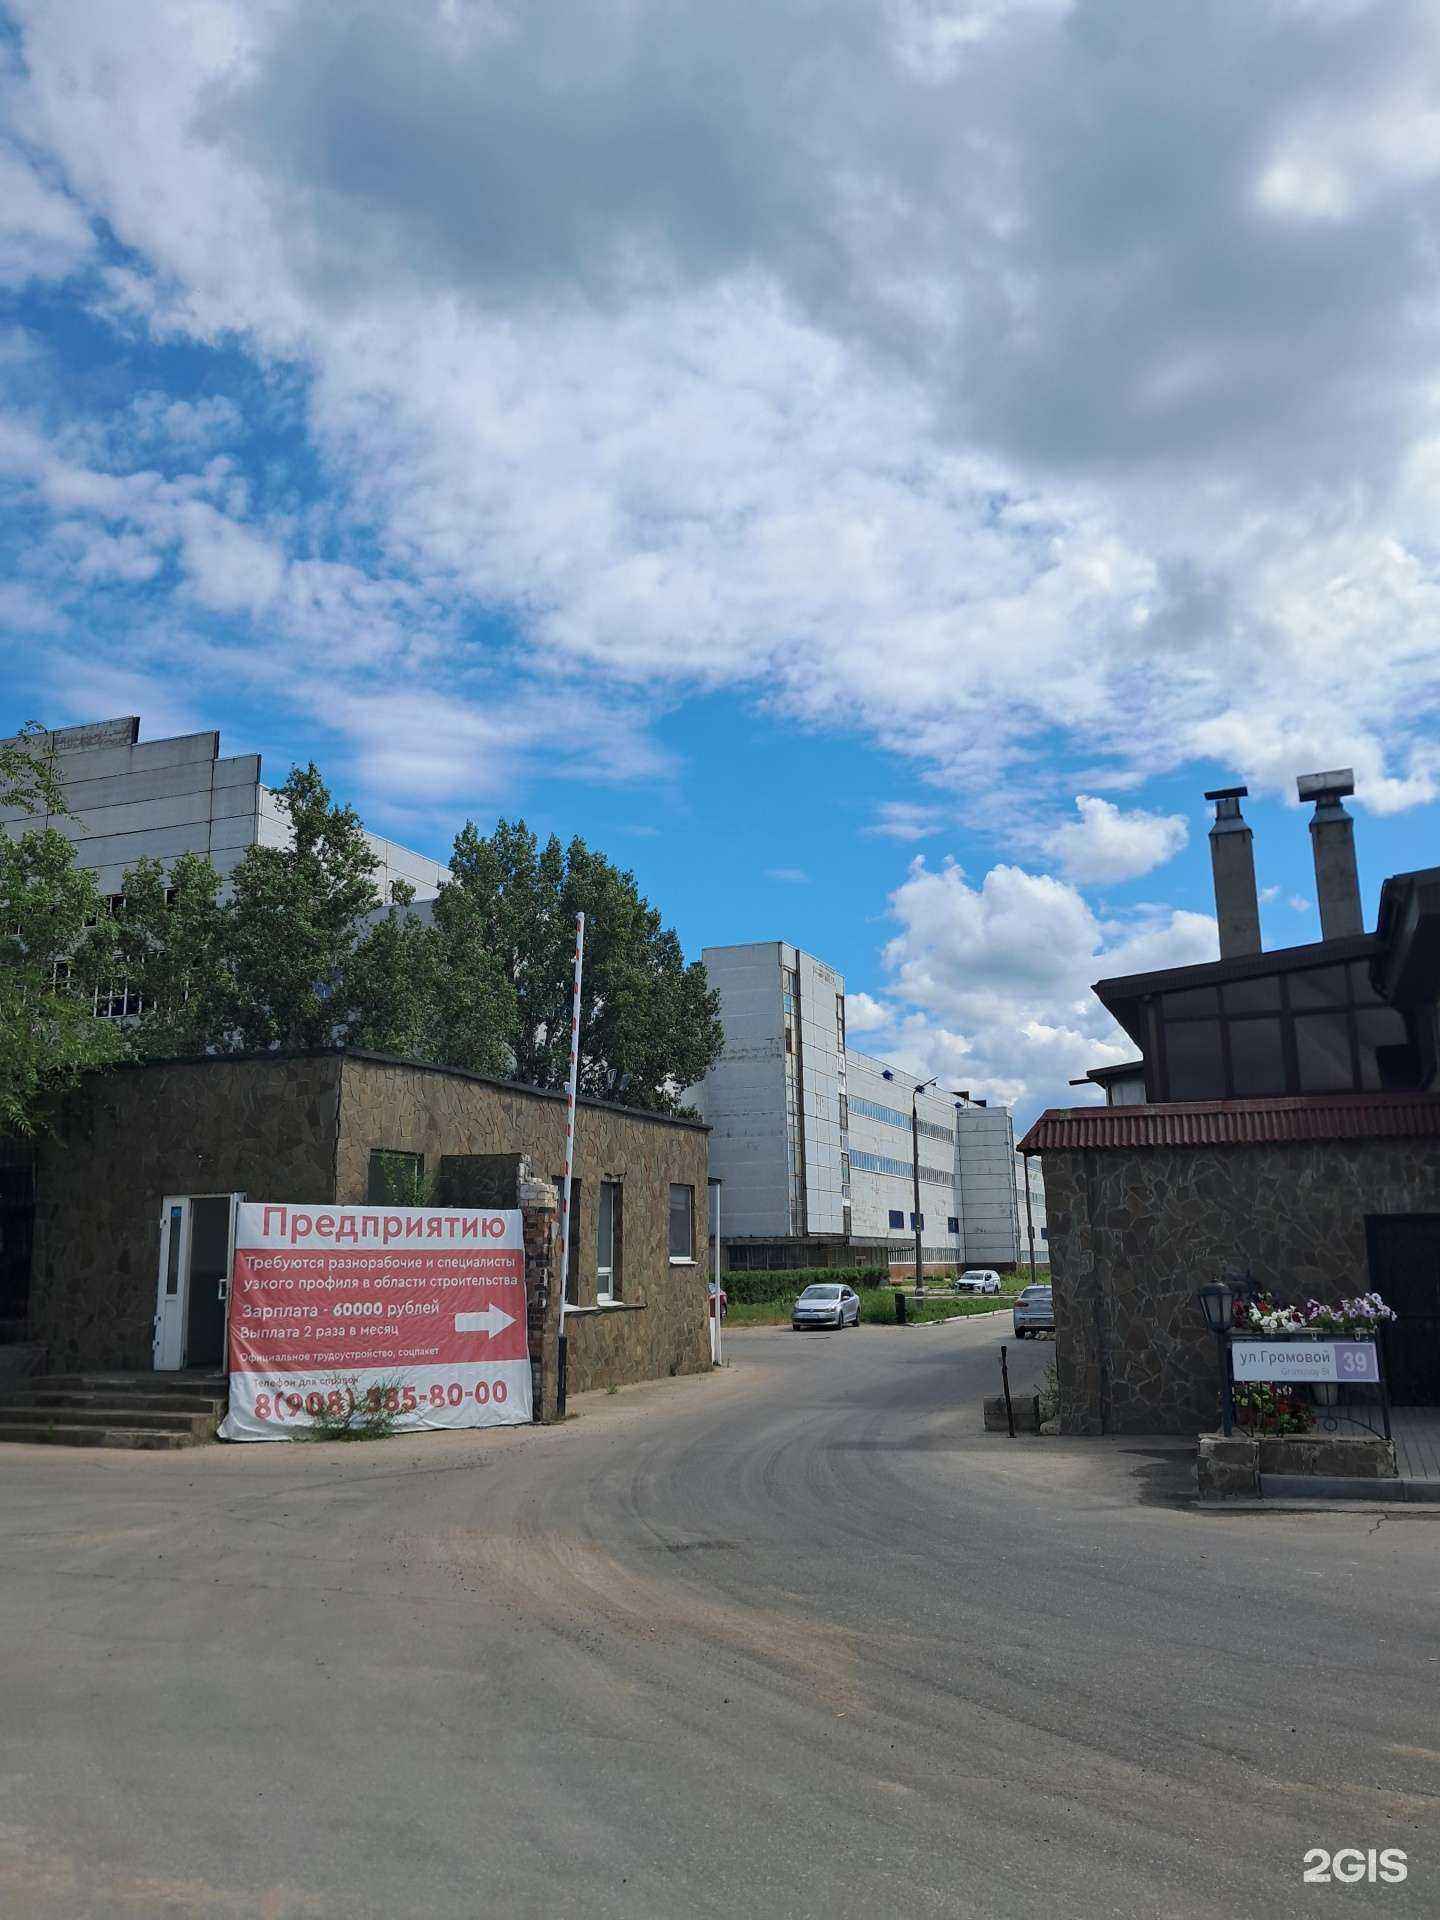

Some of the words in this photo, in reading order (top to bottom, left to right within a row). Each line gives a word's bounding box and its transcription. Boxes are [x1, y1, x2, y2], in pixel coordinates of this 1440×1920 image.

[262, 1206, 506, 1245] Предприятию
[245, 1255, 324, 1271] Требуются
[328, 1255, 422, 1271] разнорабочие
[426, 1258, 434, 1268] и
[437, 1257, 516, 1271] специалисты
[243, 1277, 294, 1292] узкого
[298, 1275, 359, 1291] профиля
[362, 1278, 370, 1288] в
[374, 1274, 426, 1288] области
[430, 1276, 518, 1289] строительства
[242, 1304, 318, 1320] Зарплата
[333, 1301, 383, 1317] 60000
[387, 1298, 440, 1318] рублей
[240, 1326, 300, 1339] Выплата
[303, 1325, 312, 1338] 2
[315, 1327, 346, 1341] раза
[349, 1326, 357, 1336] в
[360, 1325, 399, 1338] месяц
[240, 1352, 310, 1363] Официальное
[313, 1348, 396, 1362] трудоустройство,
[399, 1347, 439, 1358] соцпакет
[1239, 1349, 1331, 1366] ул.Громовой
[1343, 1351, 1368, 1372] 39
[298, 1378, 317, 1388] для
